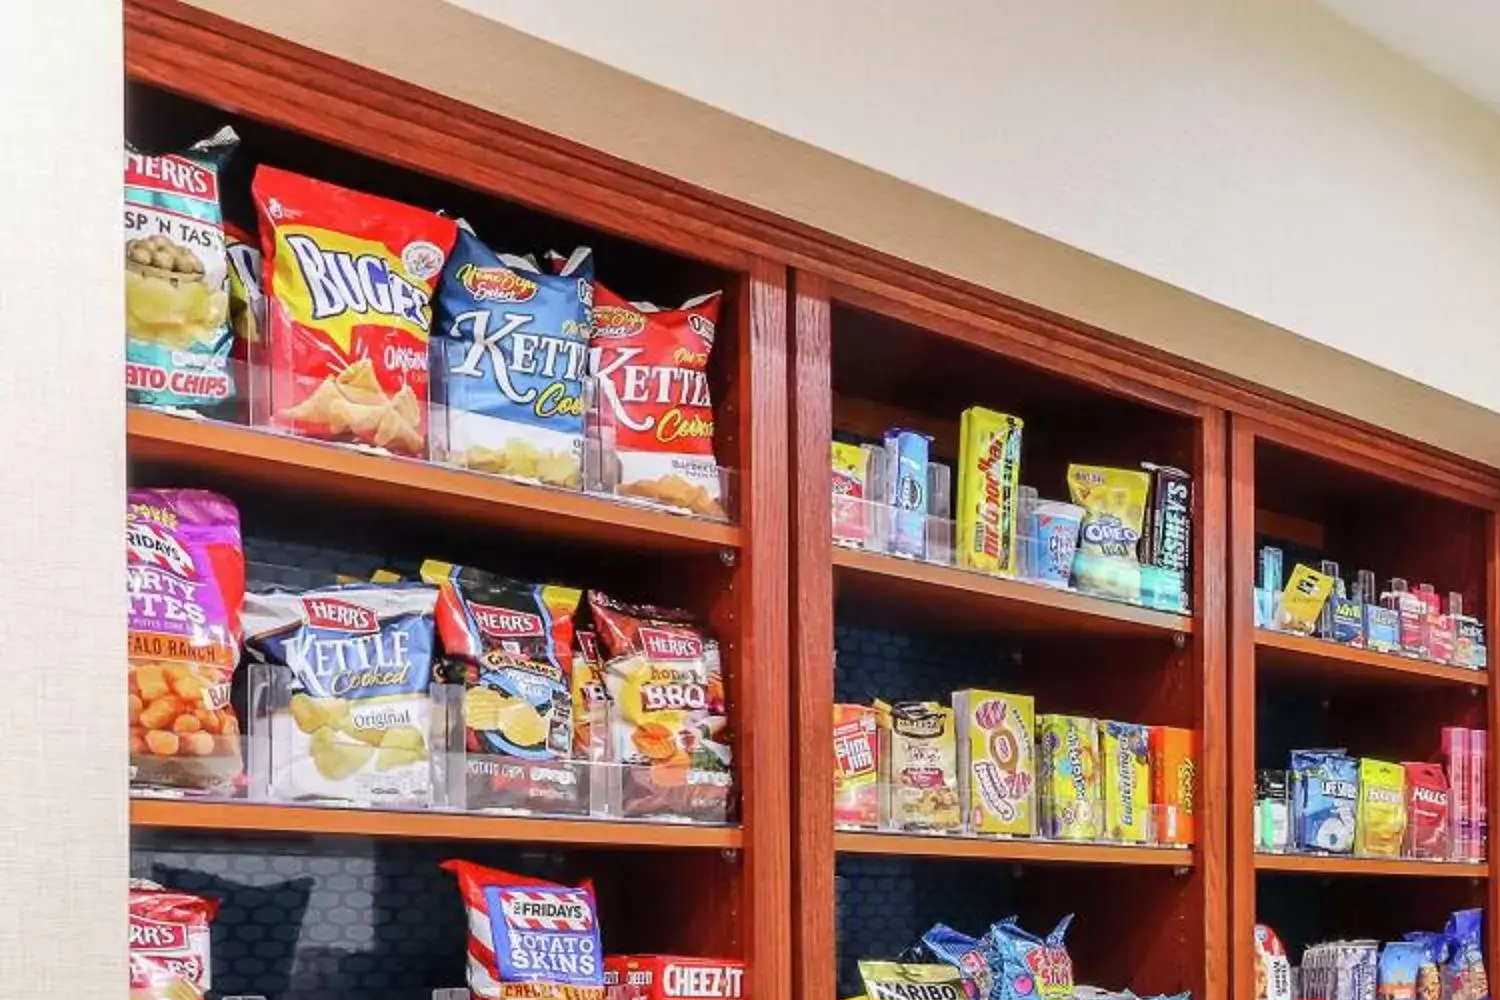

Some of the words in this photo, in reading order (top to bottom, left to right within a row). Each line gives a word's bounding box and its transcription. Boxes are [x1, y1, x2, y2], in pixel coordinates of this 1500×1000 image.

[171, 372, 227, 397] CHIPS
[312, 600, 370, 630] HERR'S
[476, 612, 536, 633] HERR'S
[649, 636, 699, 656] HERR'S
[280, 631, 412, 698] KETTLE
[330, 664, 410, 695] Cooked
[641, 684, 707, 711] BBQ
[354, 709, 411, 729] Original
[1413, 787, 1448, 805] HALLS
[522, 900, 583, 919] FRIDAYS
[508, 932, 594, 953] POTATO
[511, 950, 595, 975] SKINS
